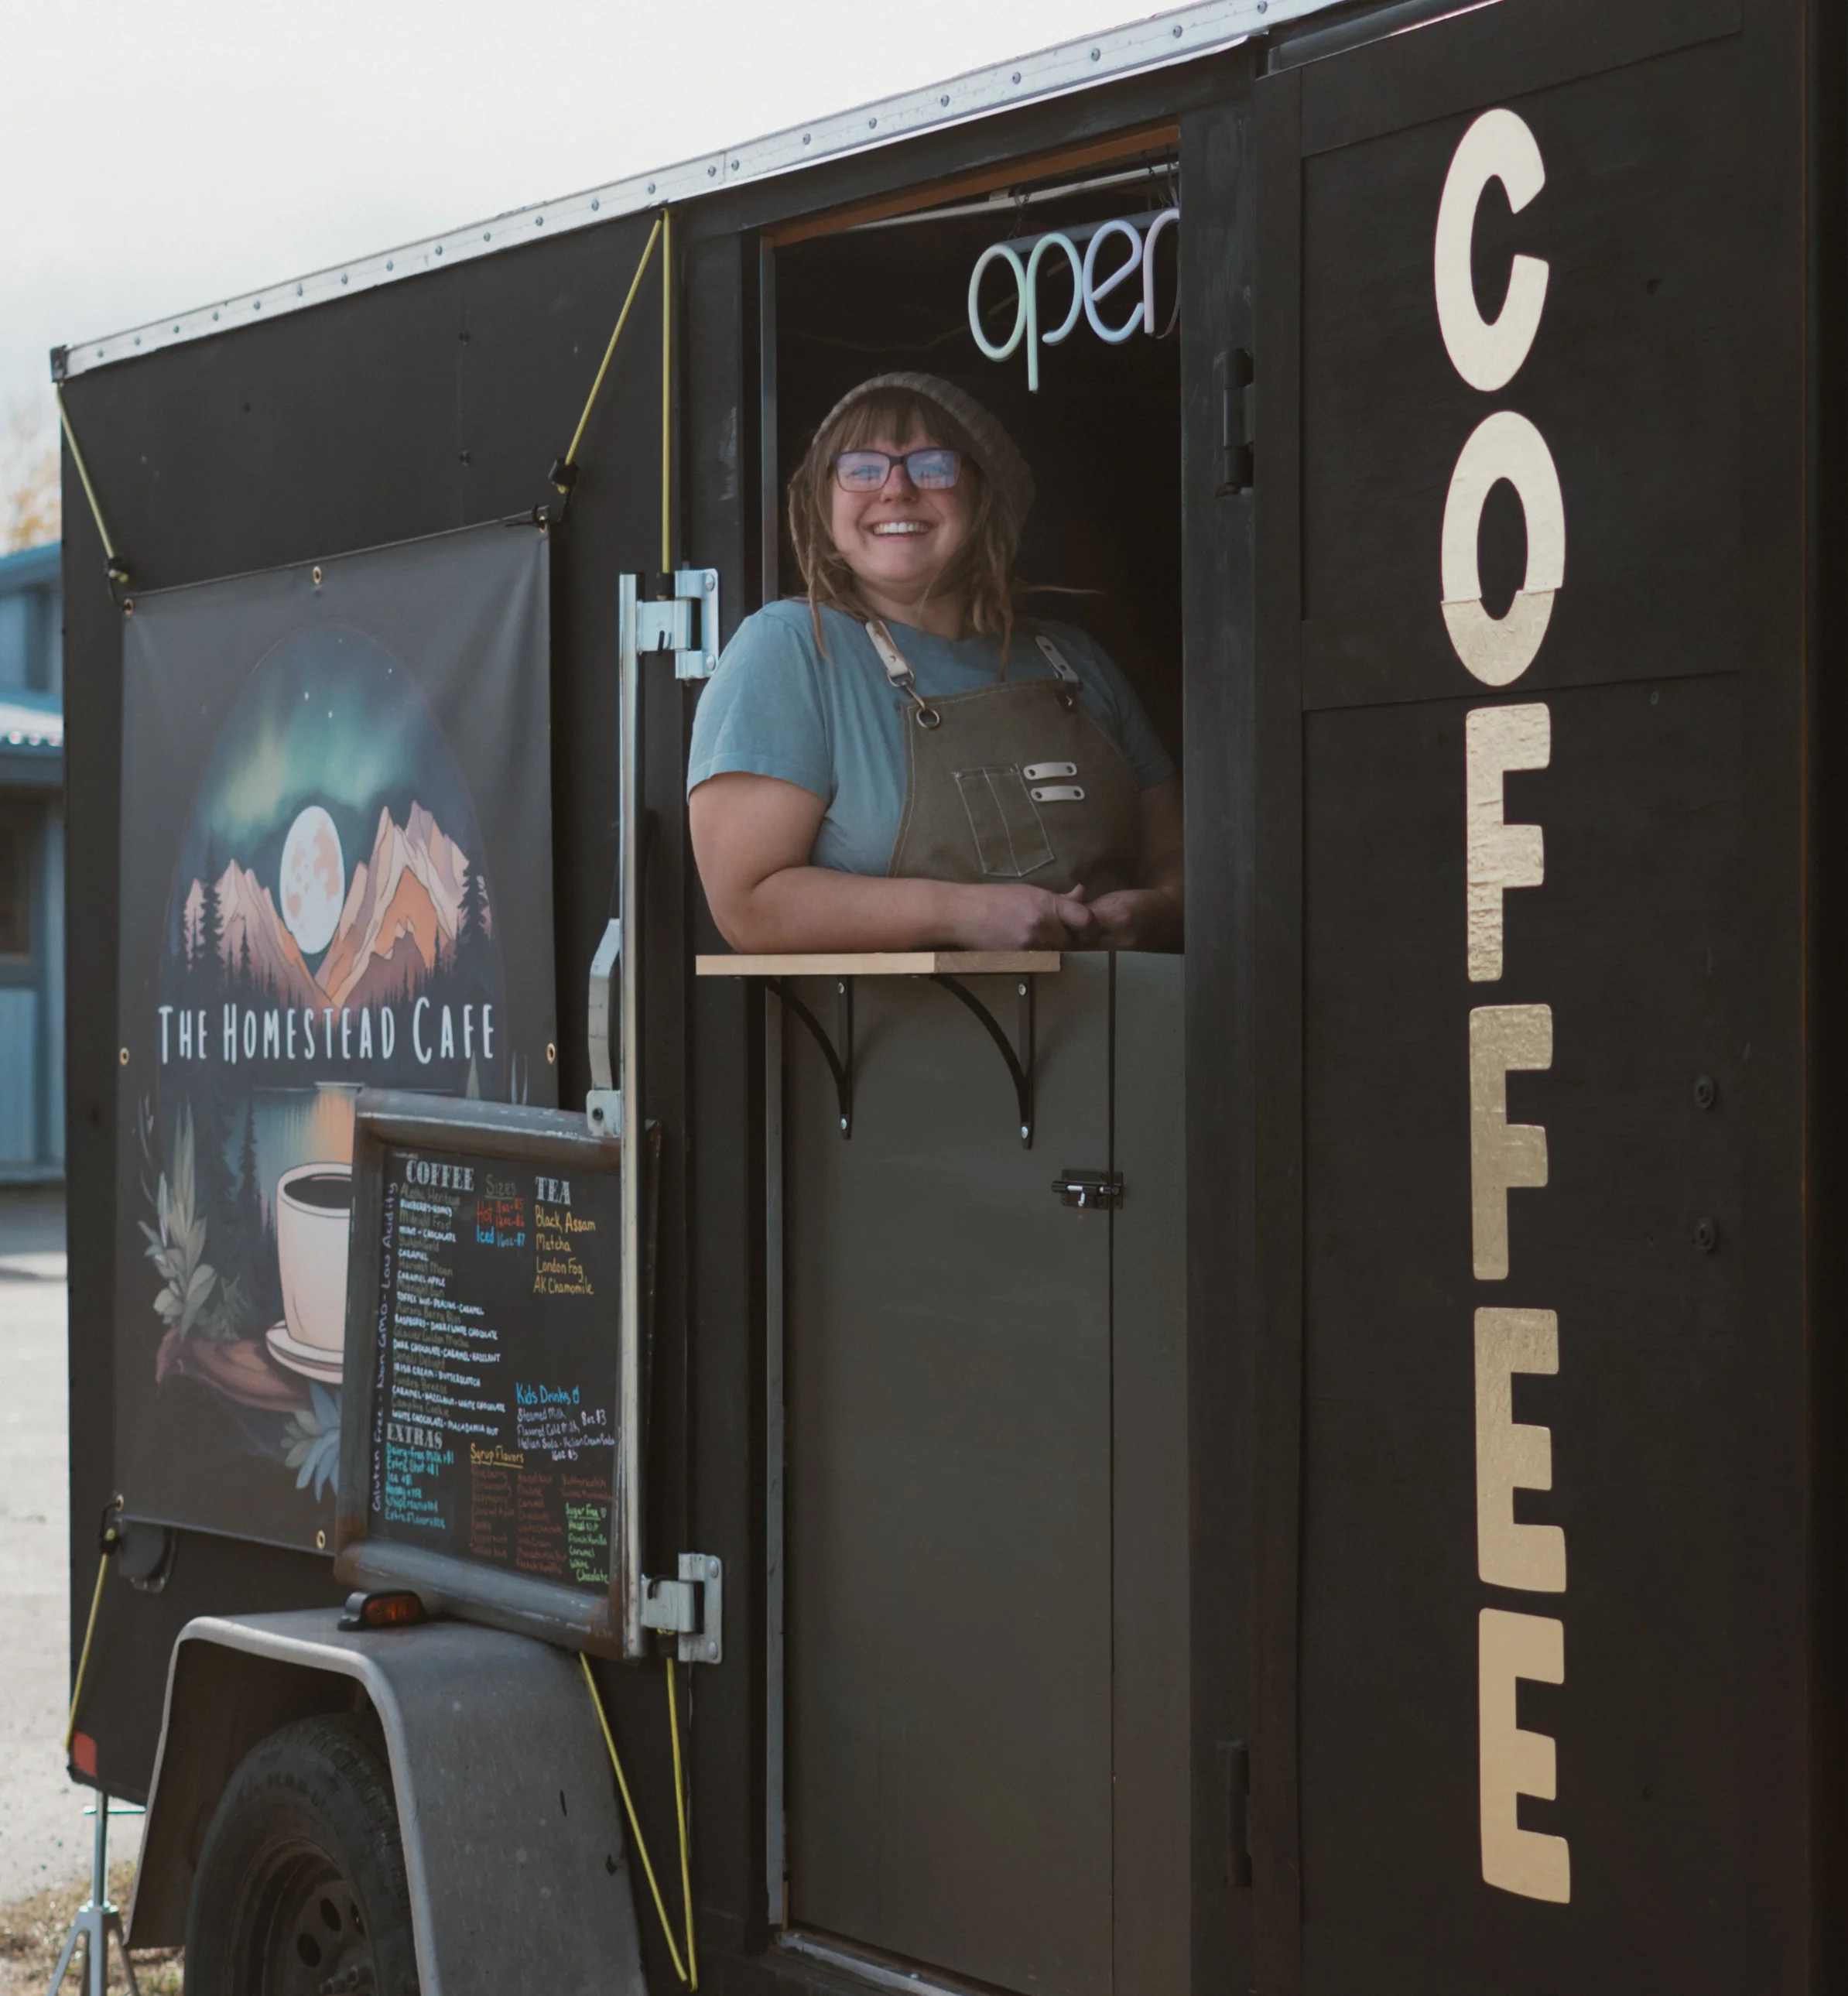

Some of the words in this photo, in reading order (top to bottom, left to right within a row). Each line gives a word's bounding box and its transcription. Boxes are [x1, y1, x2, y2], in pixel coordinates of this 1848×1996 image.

[1433, 108, 1571, 1905] COFFEE
[158, 1005, 207, 1064] THE
[223, 1003, 395, 1064] HOMESTEAD
[412, 996, 495, 1064] CAFE
[406, 1159, 475, 1191] COFFEE
[486, 1173, 518, 1197] Sizes
[536, 1176, 572, 1205] TEA
[382, 1181, 399, 1248] Acidity
[476, 1199, 494, 1224] Hot
[535, 1204, 563, 1235] Black
[566, 1211, 597, 1234] Assam
[476, 1224, 495, 1245] Iced
[536, 1233, 573, 1253] Matcha
[381, 1254, 392, 1288] Low
[536, 1255, 567, 1275] London
[568, 1256, 584, 1283] Fog
[533, 1275, 547, 1294] AK
[548, 1275, 595, 1296] Chamomile
[515, 1381, 538, 1405] Kids
[539, 1384, 572, 1406] Drinks
[373, 1407, 385, 1443] Free
[387, 1423, 443, 1450] EXTRAS
[471, 1442, 496, 1467] Syrup
[496, 1444, 525, 1463] Flavors
[372, 1450, 382, 1512] Gluten
[569, 1545, 596, 1559] Caramel
